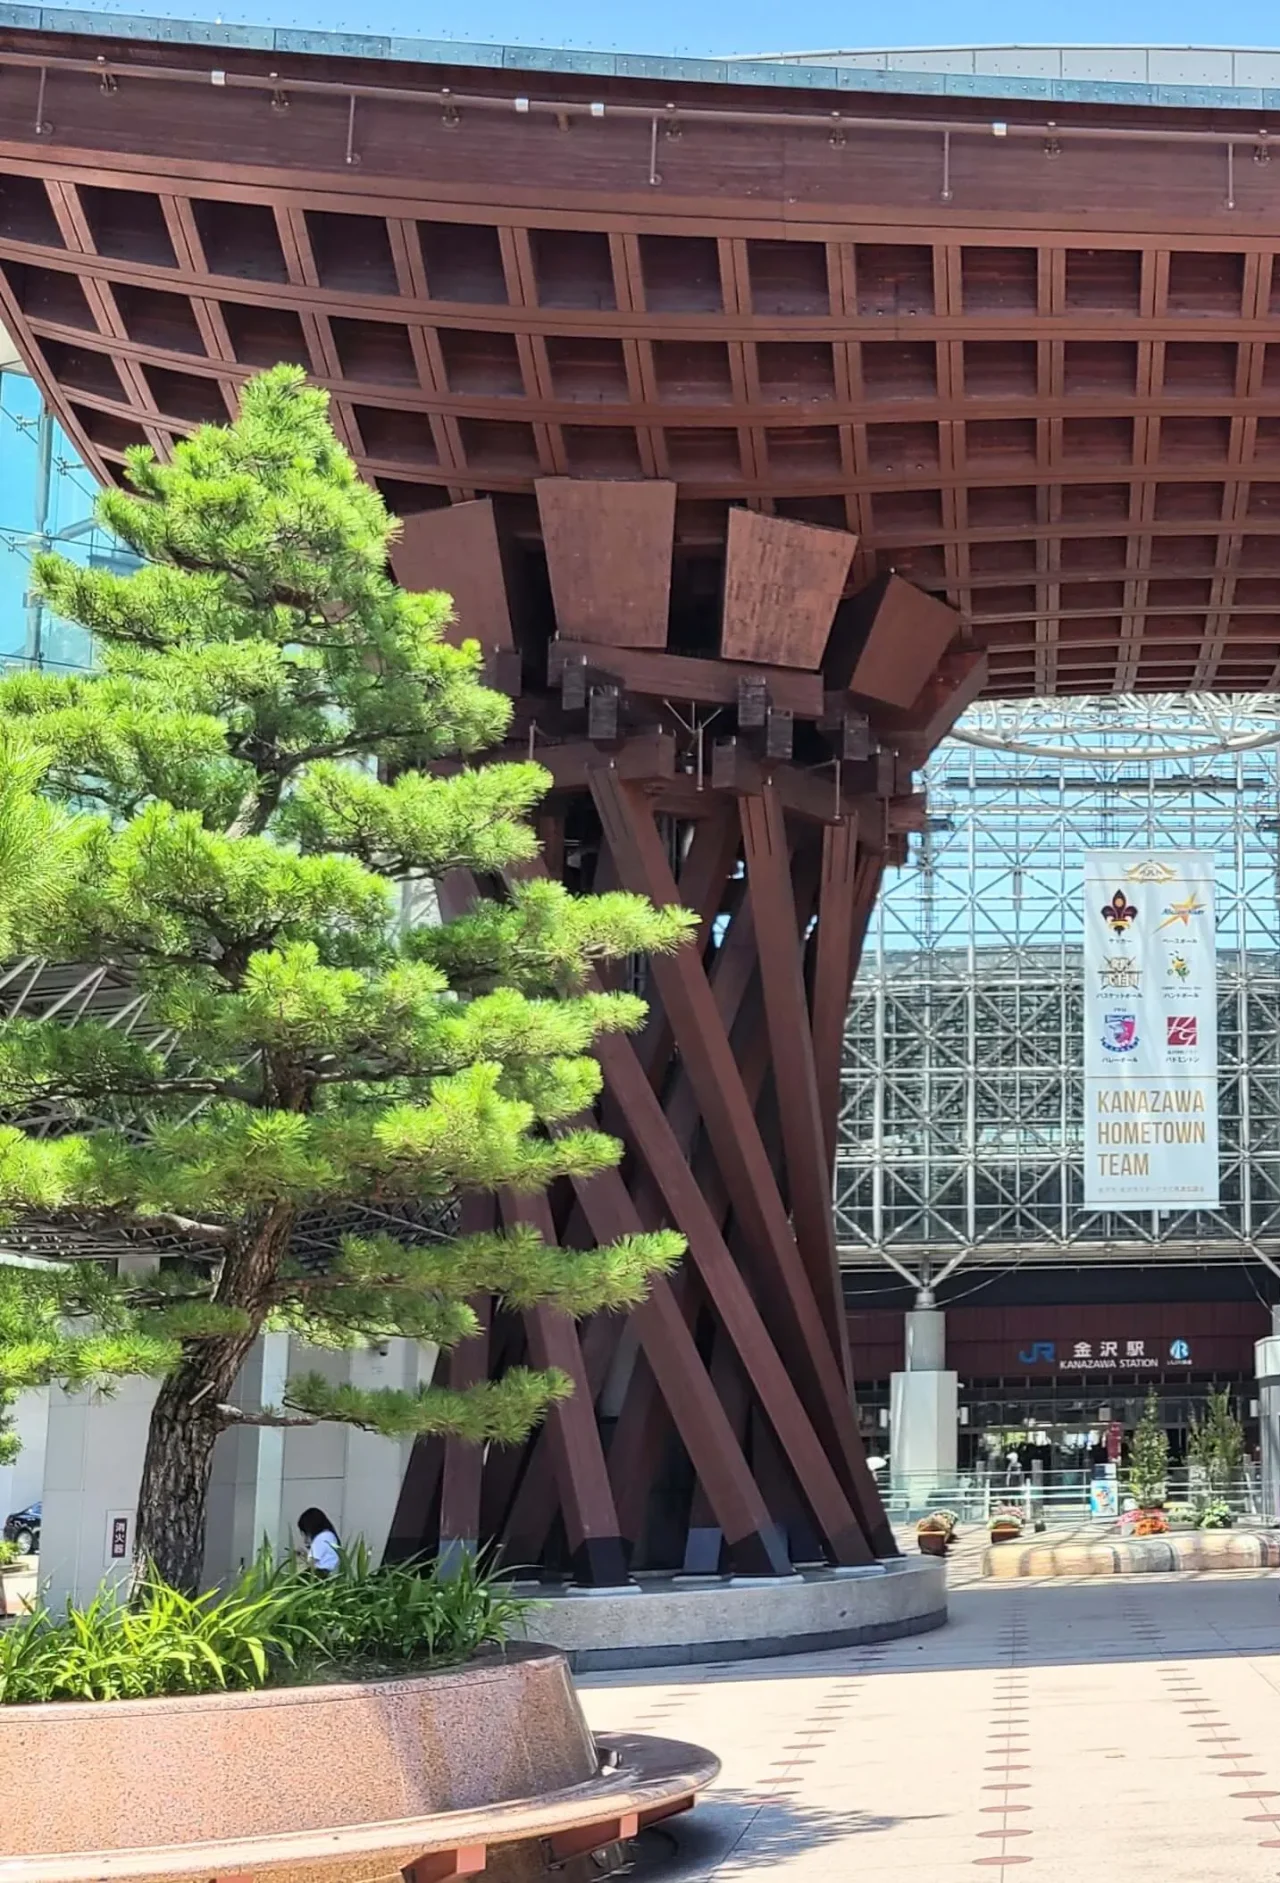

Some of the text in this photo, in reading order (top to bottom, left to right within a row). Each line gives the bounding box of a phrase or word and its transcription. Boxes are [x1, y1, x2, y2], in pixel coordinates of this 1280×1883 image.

[1097, 1090, 1205, 1113] KANAZAWA
[1097, 1121, 1206, 1145] HOMETOWN
[1097, 1153, 1149, 1176] TEAM
[1019, 1341, 1056, 1363] JR
[1073, 1341, 1144, 1357] 金沢駅
[1059, 1360, 1117, 1369] KANAZAWA
[1119, 1359, 1158, 1368] STATION
